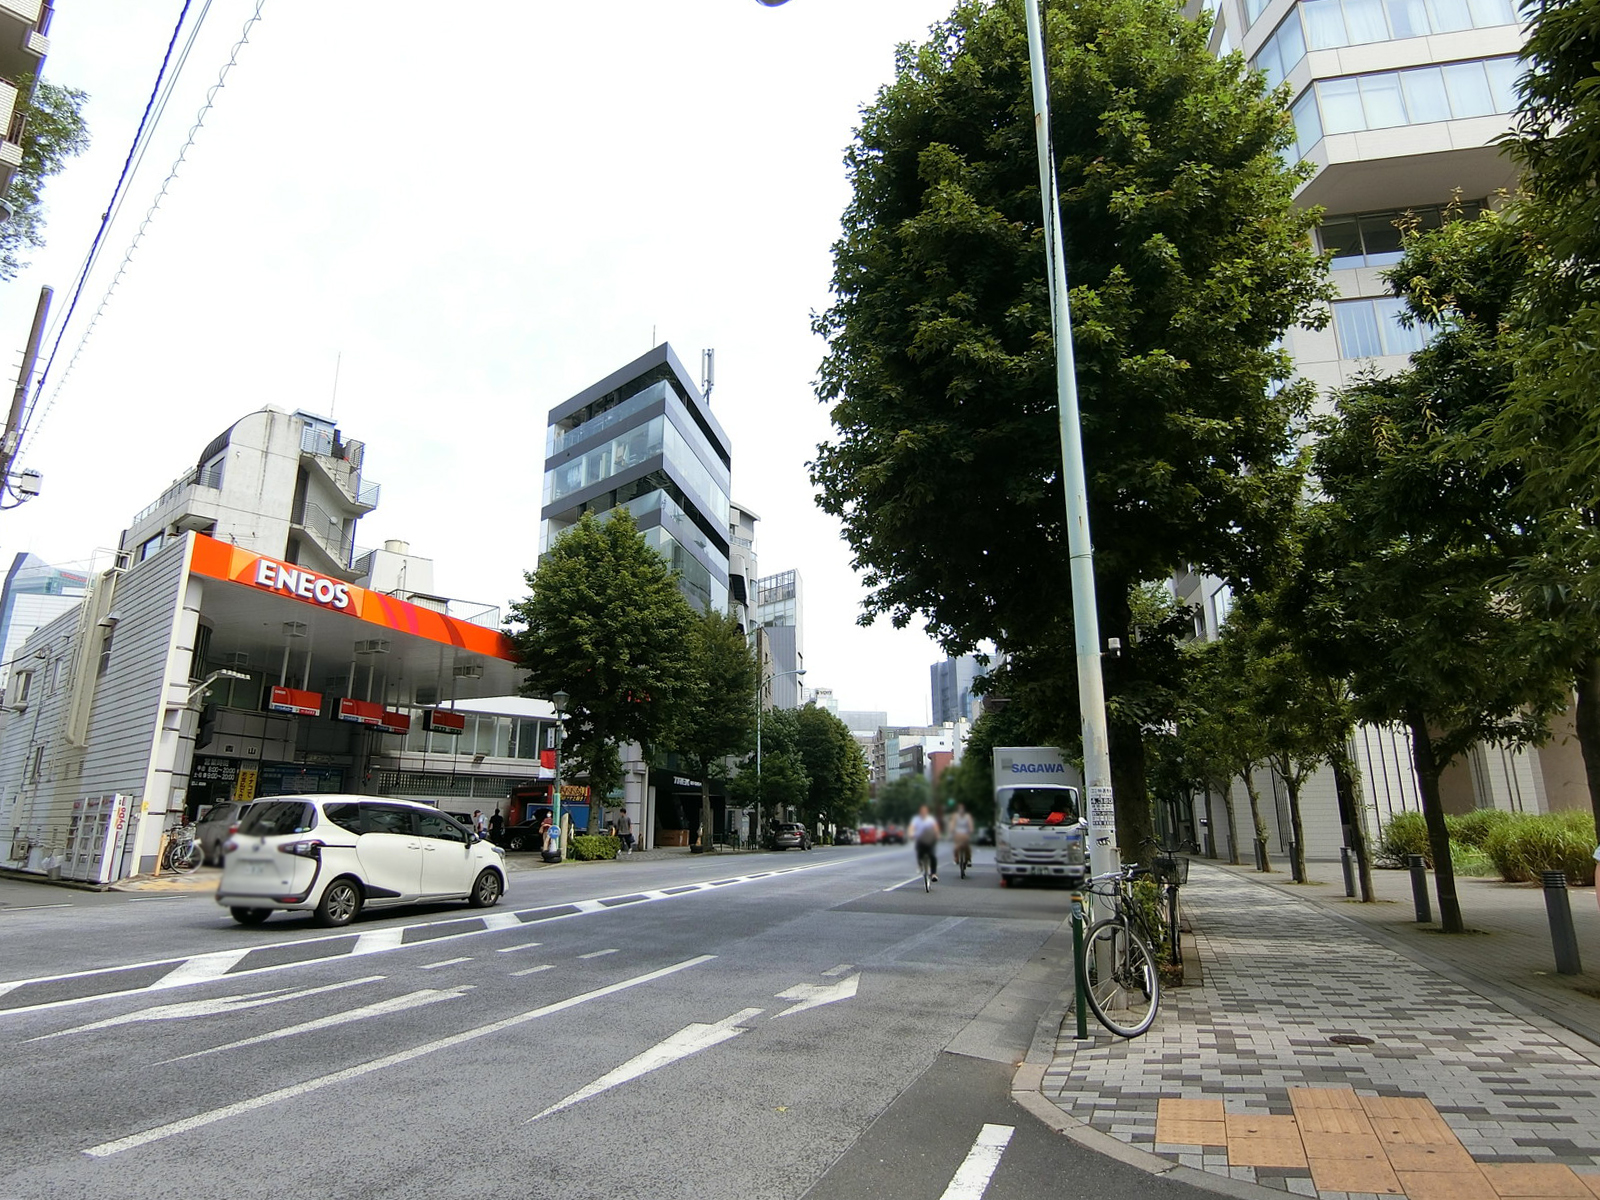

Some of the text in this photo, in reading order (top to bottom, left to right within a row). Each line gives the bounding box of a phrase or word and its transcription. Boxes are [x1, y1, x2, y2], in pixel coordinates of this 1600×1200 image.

[255, 558, 350, 609] ENEOS
[1011, 763, 1065, 773] SAGAWA
[116, 807, 126, 830] DyDo
